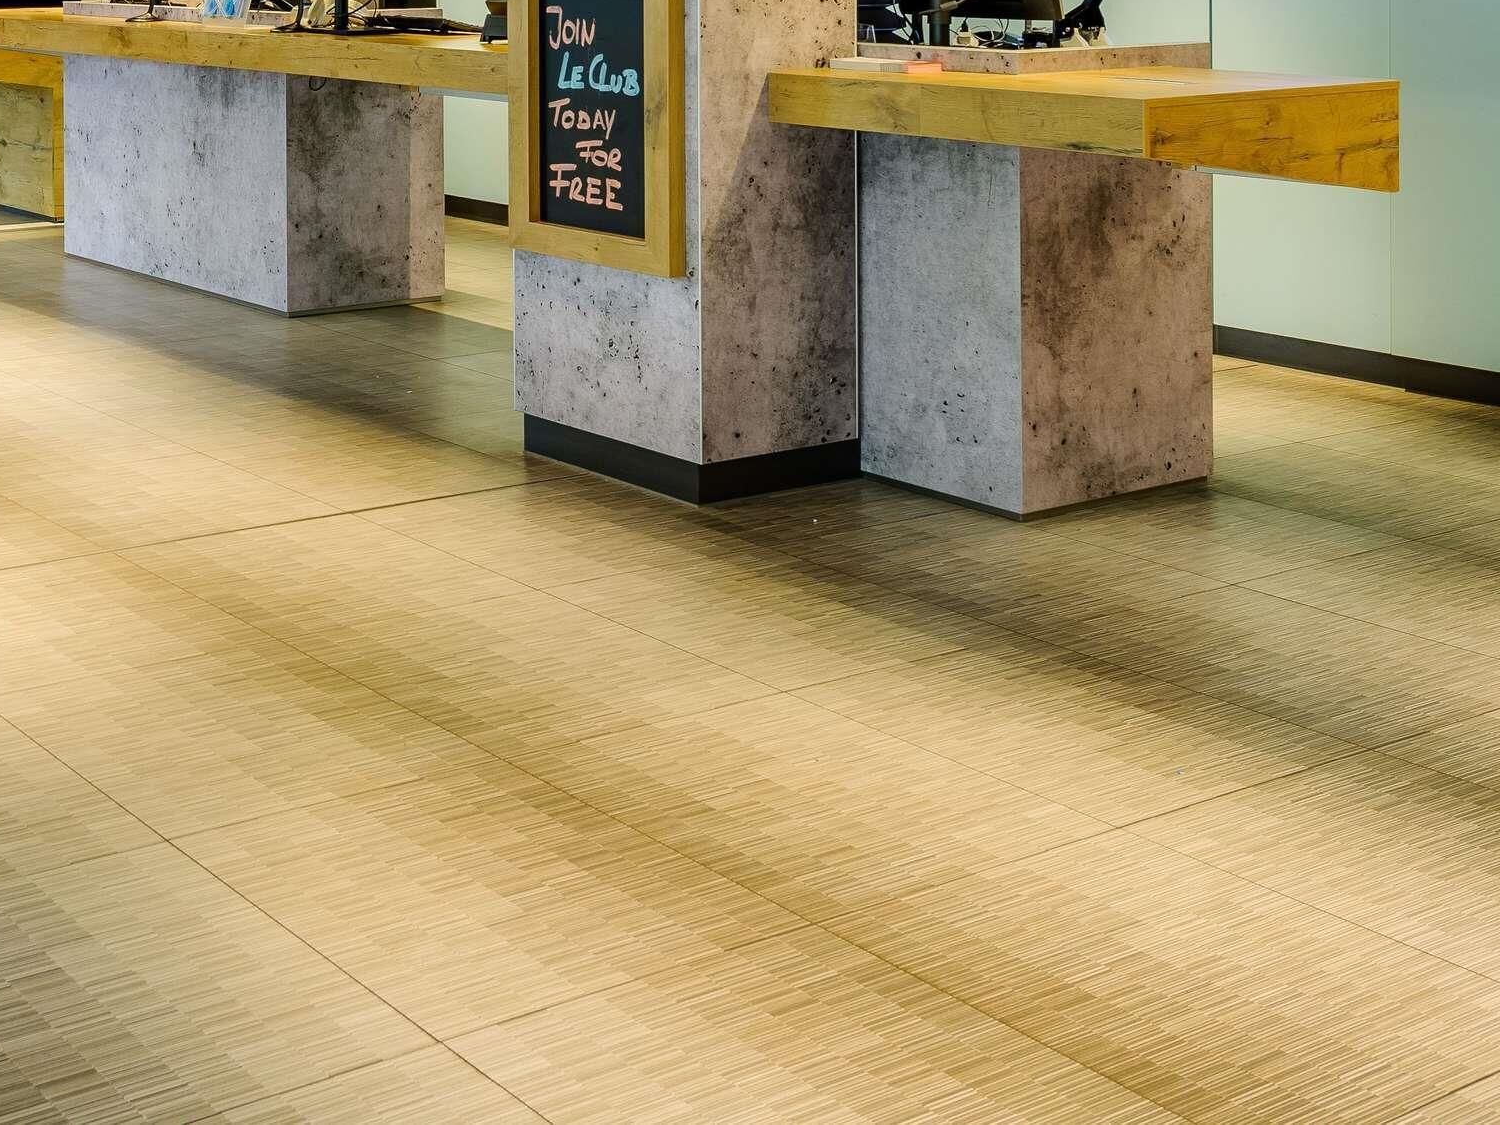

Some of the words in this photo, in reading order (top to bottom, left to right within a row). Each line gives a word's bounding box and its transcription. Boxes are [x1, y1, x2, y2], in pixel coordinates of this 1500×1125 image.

[546, 5, 596, 50] JOIN
[557, 51, 585, 90] LE
[587, 53, 640, 97] CLUB
[547, 97, 616, 140] TODAY
[575, 139, 622, 173] FOR
[549, 163, 624, 211] FREE
